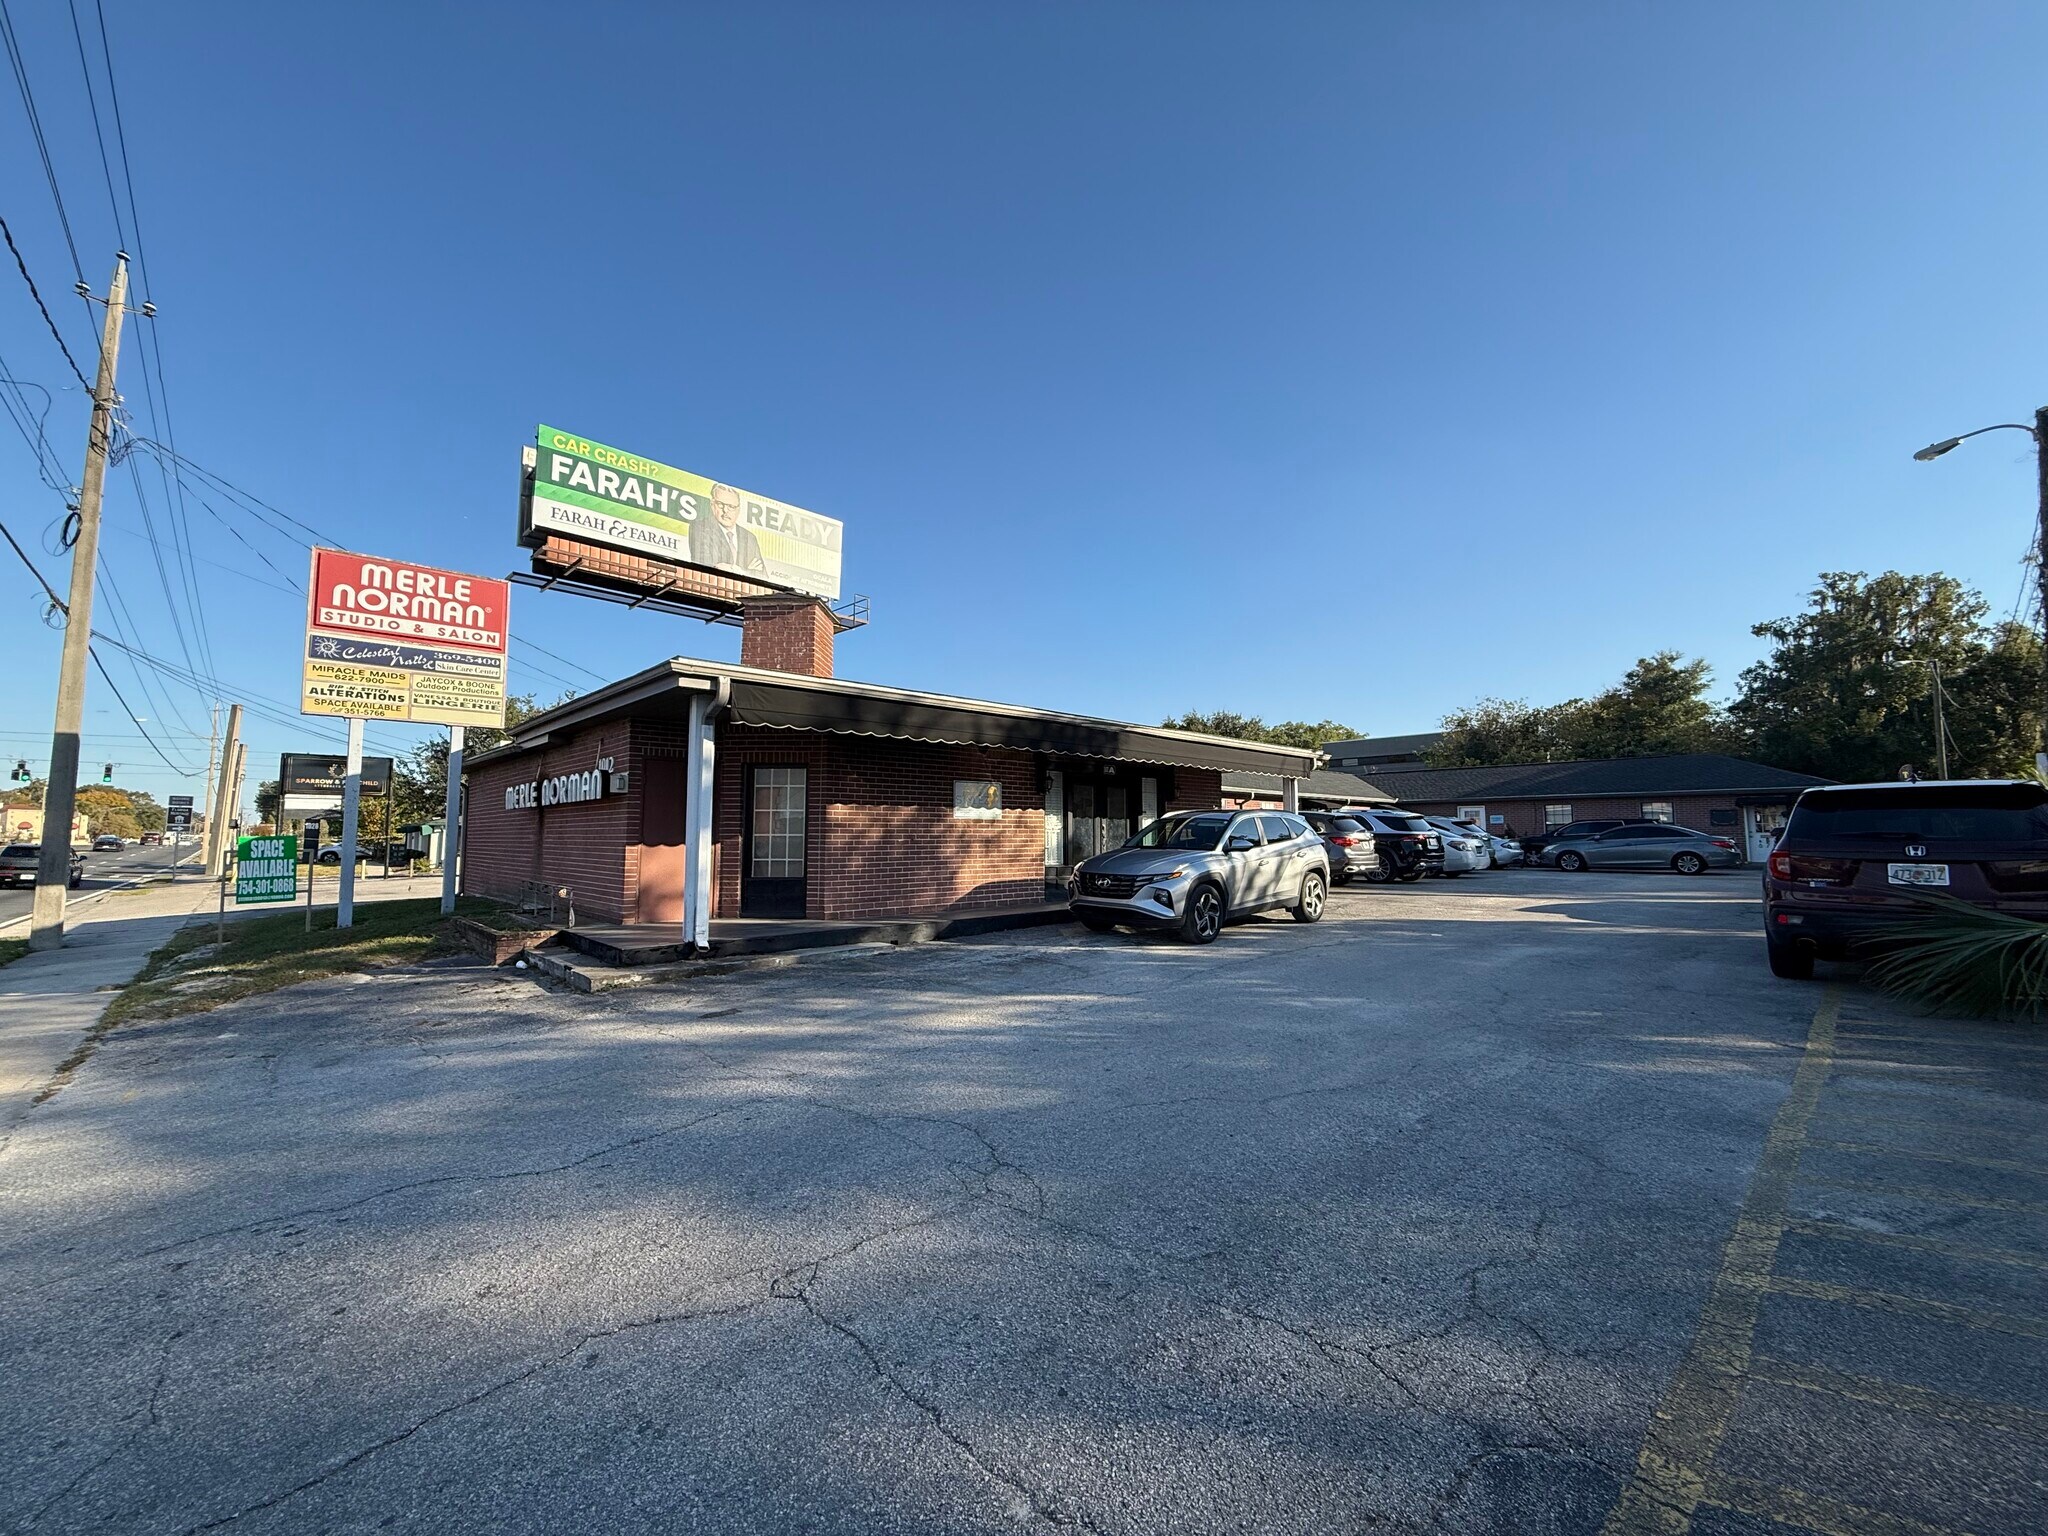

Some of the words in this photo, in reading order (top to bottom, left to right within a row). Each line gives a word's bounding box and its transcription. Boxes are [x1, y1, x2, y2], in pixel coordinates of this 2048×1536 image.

[553, 434, 591, 456] CAR
[594, 448, 659, 478] CRASH?
[551, 454, 698, 521] FARAH'S
[550, 506, 606, 531] FARAH
[608, 520, 628, 538] &
[630, 528, 677, 550] FARAH
[746, 502, 835, 546] READY
[361, 563, 471, 603] MERLE
[324, 610, 400, 630] STUDIO
[414, 624, 424, 634] &
[438, 627, 496, 644] SALON
[434, 652, 500, 666] 369-5400
[312, 665, 365, 676] MIRACLE
[370, 671, 406, 680] MAIDS
[334, 674, 384, 684] 622-7900
[416, 682, 450, 691] Outdoor
[452, 686, 500, 696] Productions
[421, 677, 456, 686] JAYCOX
[466, 681, 496, 689] BOONE
[309, 688, 405, 702] ALTERATIONS
[314, 699, 348, 708] SPACE
[350, 702, 402, 712] AVAILABLE
[344, 708, 385, 716] 351-5766
[413, 699, 501, 711] LINGERIE
[505, 782, 538, 810] MERLE
[542, 769, 602, 806] NORMAN
[251, 840, 284, 858] SPACE
[239, 859, 294, 878] AVAILABLE
[238, 878, 294, 894] 754-301-0868
